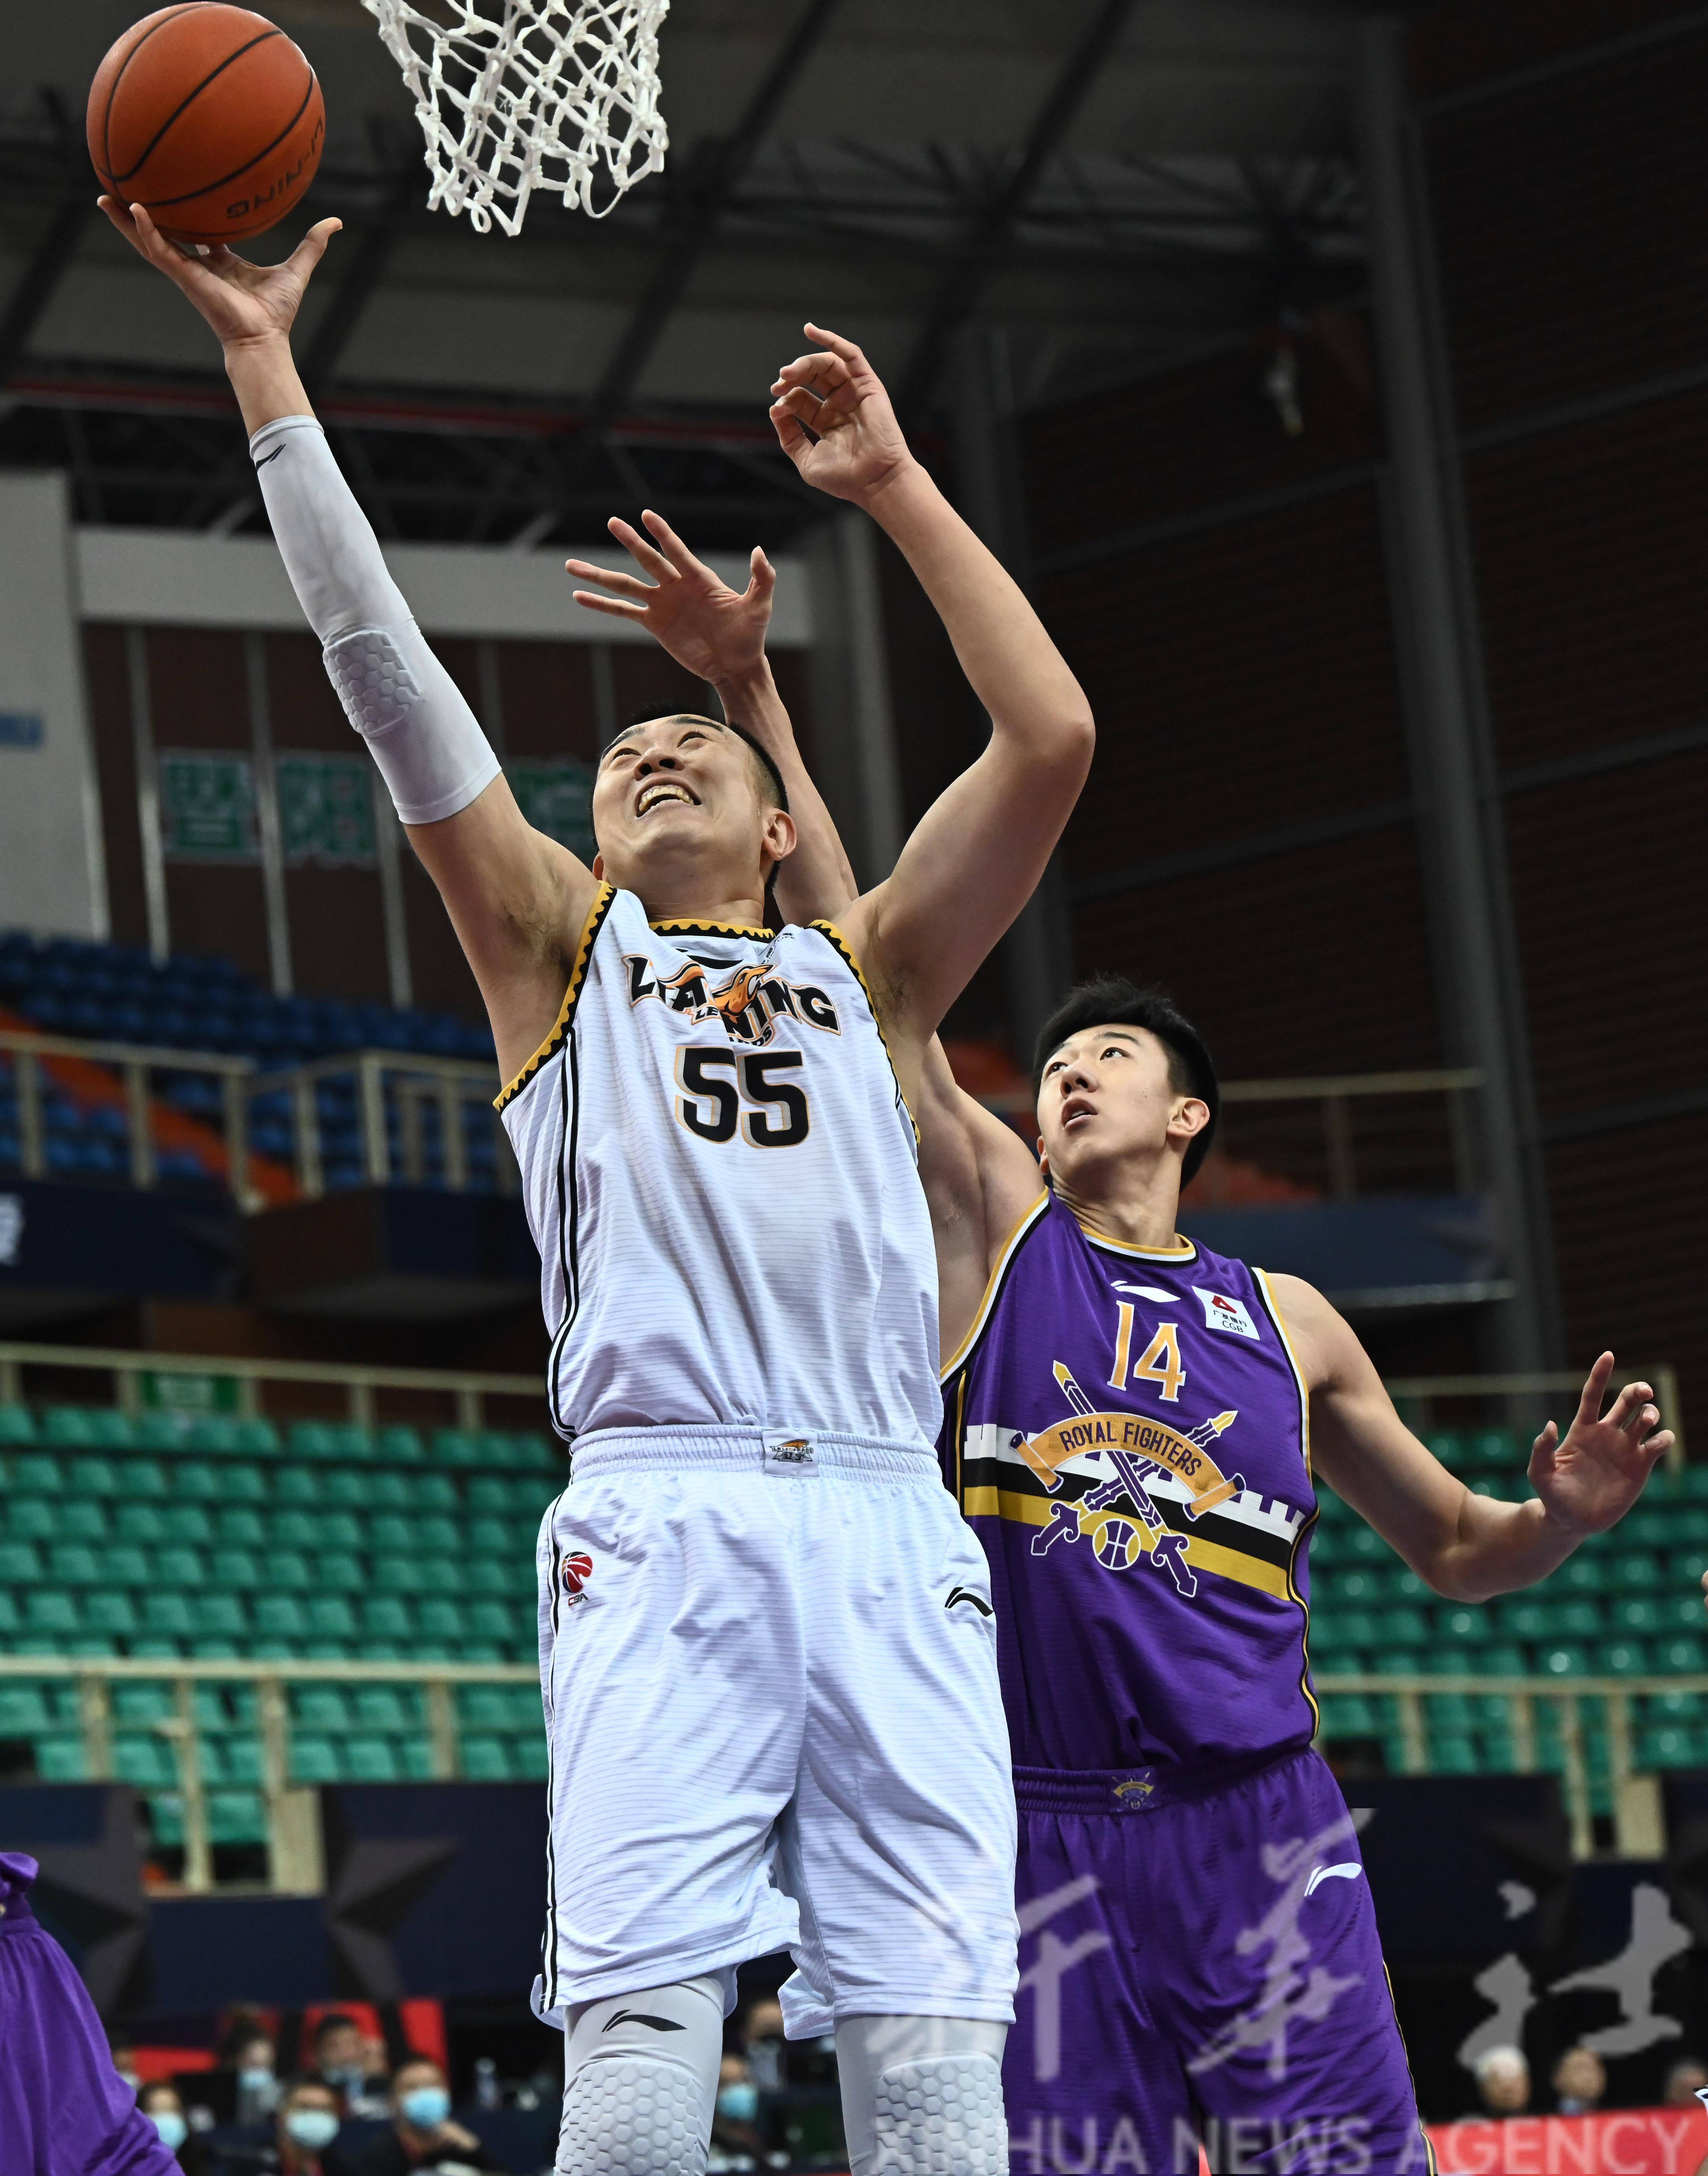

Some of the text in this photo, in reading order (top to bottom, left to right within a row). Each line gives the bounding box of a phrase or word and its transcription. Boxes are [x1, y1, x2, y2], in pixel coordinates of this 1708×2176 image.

[674, 1046, 809, 1148] 55
[1213, 1309, 1247, 1327] 广发银行
[1222, 1320, 1243, 1333] CGB
[1107, 1300, 1186, 1402] 14
[1059, 1421, 1202, 1477] ROYAL FIGHTERS
[568, 1592, 589, 1607] CBA
